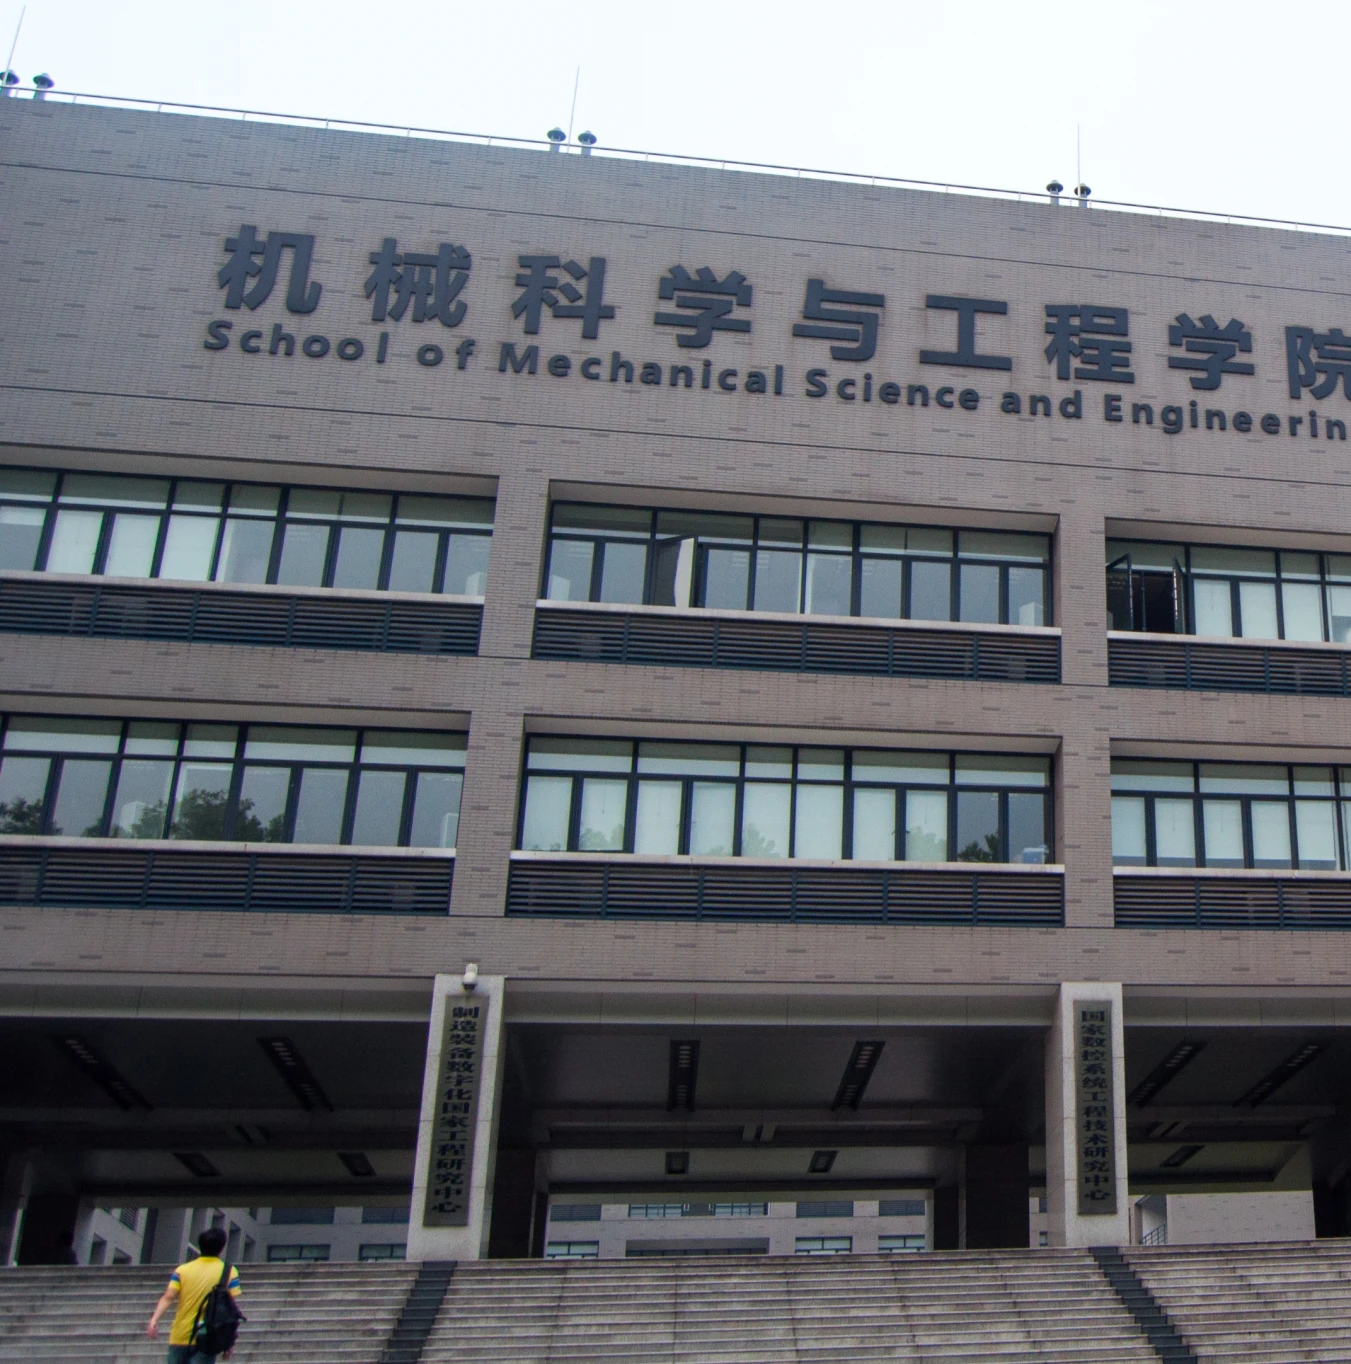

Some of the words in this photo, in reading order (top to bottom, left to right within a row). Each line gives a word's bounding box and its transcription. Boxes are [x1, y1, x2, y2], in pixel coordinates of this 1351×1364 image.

[204, 320, 389, 363] School
[416, 338, 475, 370] of
[498, 342, 784, 395] Mechanical
[805, 368, 979, 411] Science
[1000, 389, 1082, 419] and
[431, 1005, 479, 1214] 制造装备数字化国家工程研究中心
[1080, 1009, 1111, 1202] 国家数控系统工程技术研究中心
